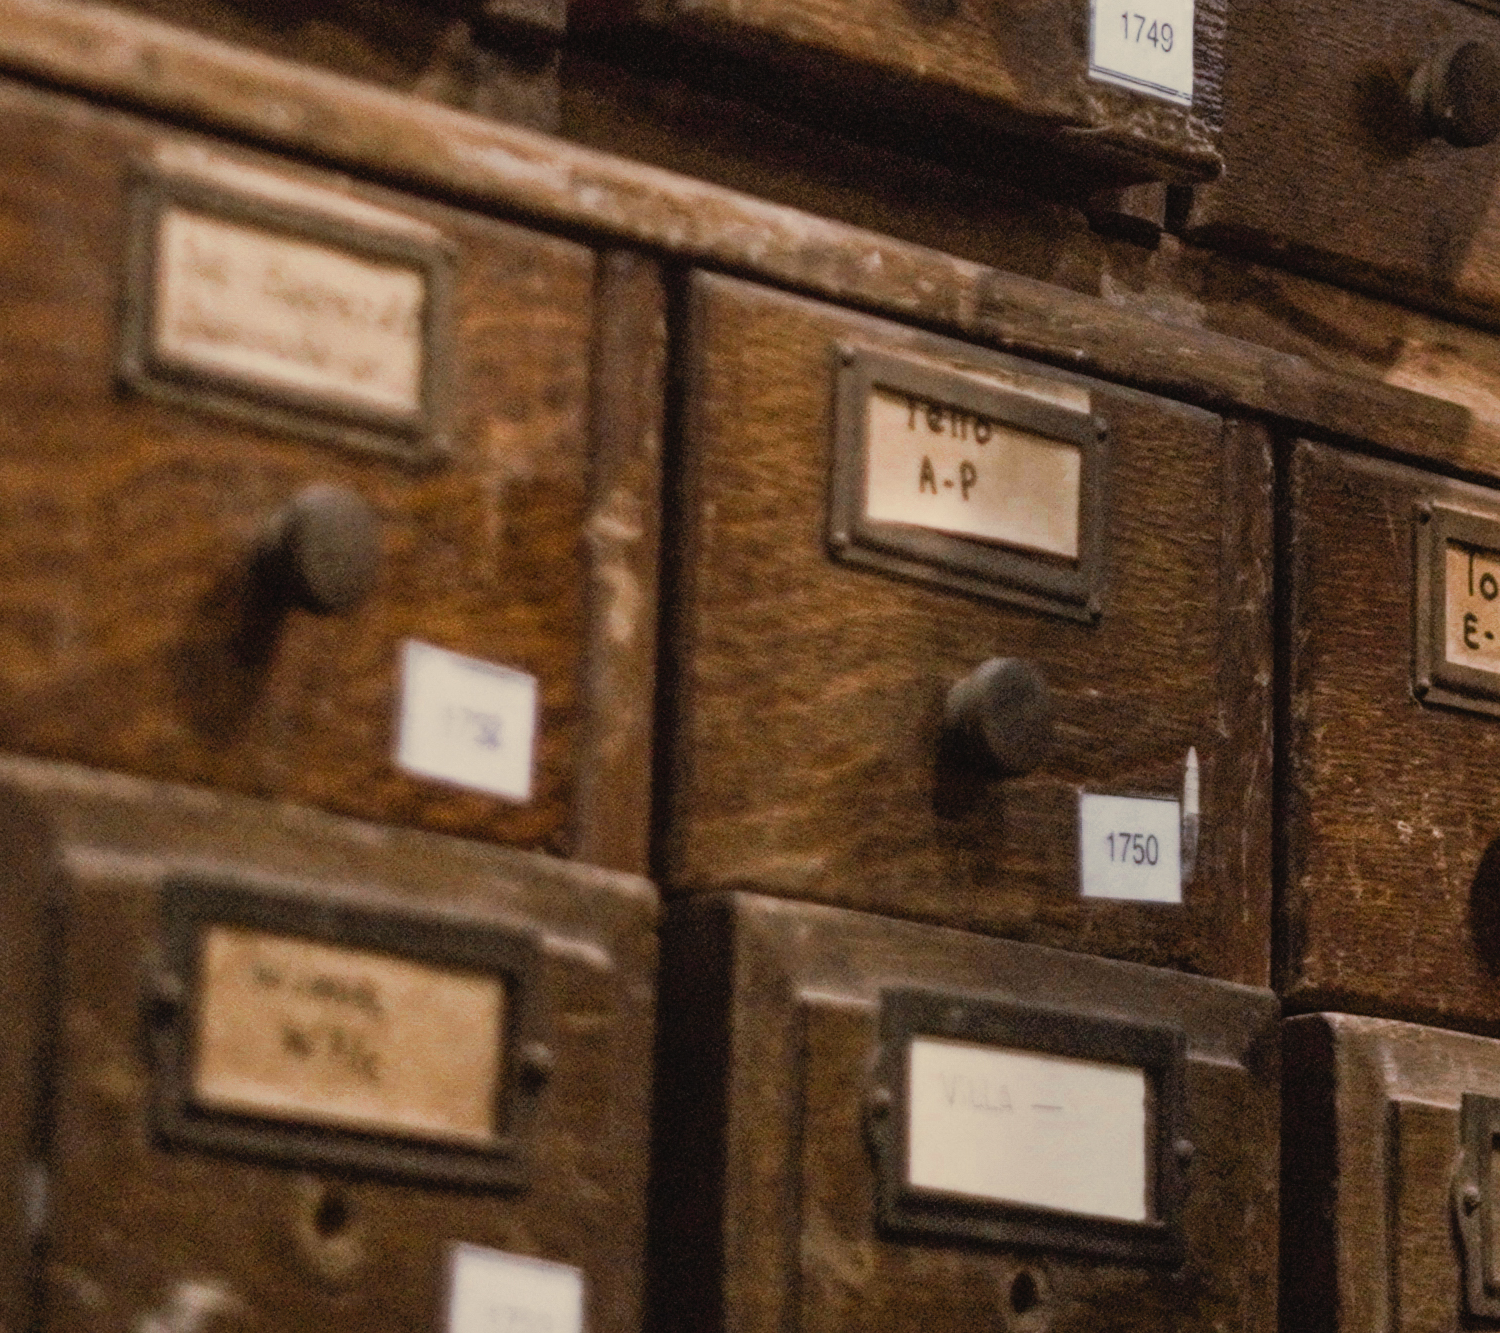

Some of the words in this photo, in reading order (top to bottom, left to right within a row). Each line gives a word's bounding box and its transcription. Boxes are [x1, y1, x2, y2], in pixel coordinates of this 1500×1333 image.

[1119, 11, 1175, 53] 1749
[917, 454, 980, 503] A-P
[1103, 831, 1160, 867] 1750
